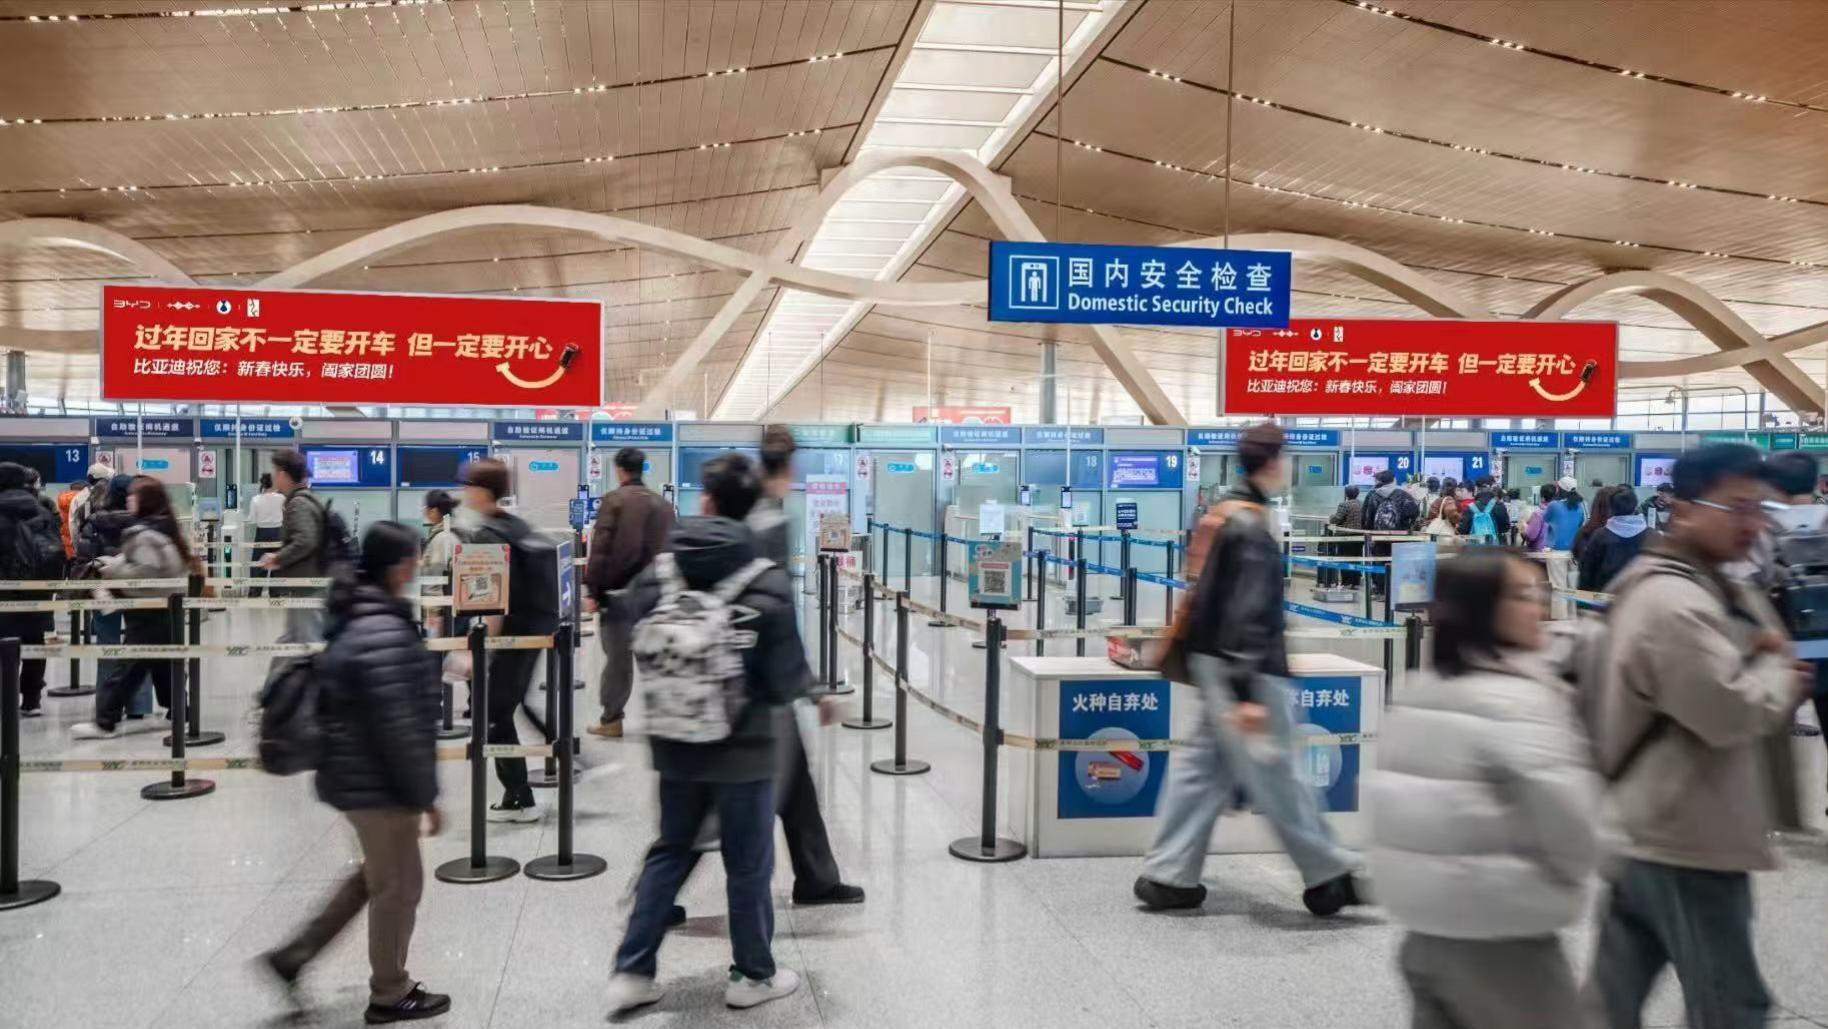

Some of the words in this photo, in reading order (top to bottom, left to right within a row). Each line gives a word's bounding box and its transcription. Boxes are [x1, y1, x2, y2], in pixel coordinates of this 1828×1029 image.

[1068, 257, 1273, 292] 国内安全检查
[1068, 293, 1147, 312] Domestic
[1152, 295, 1220, 318] Security
[1224, 297, 1273, 315] Check
[134, 324, 396, 355] 过年回家不一定要开车
[408, 332, 553, 360] 但一定要开心
[1248, 349, 1449, 375] 过年回家不一定要开车
[1458, 353, 1576, 375] 但一定要开心
[66, 449, 80, 463] 13
[370, 451, 385, 465] 14
[1085, 456, 1098, 468] 18
[1166, 455, 1178, 468] 19
[1397, 457, 1410, 469] 20
[1472, 457, 1483, 469] 21
[1072, 693, 1158, 712] 火种自弃处
